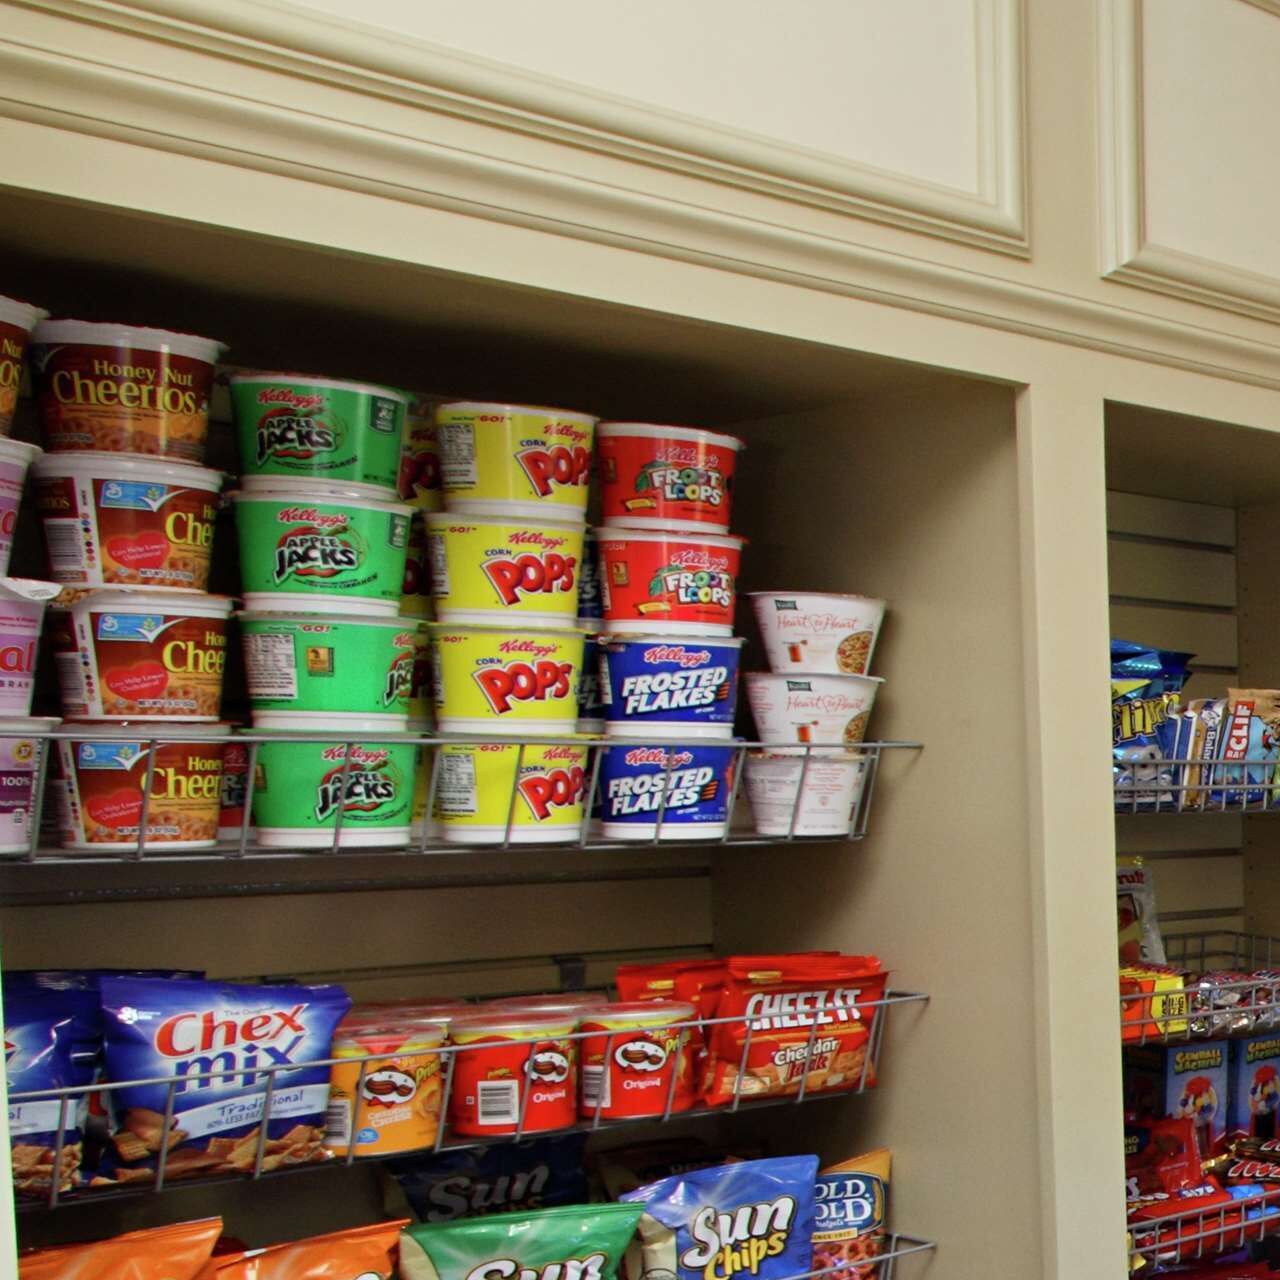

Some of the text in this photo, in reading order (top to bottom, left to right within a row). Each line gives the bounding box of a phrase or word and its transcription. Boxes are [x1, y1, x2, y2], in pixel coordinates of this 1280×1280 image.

[94, 357, 193, 388] Honey Nut
[51, 369, 197, 416] Cheerios
[258, 387, 324, 407] Kellogg's
[264, 417, 315, 430] APPLE
[256, 428, 336, 467] JACKS
[520, 439, 547, 448] CORN
[651, 467, 722, 487] FROOT
[664, 485, 723, 506] LOOPS
[277, 508, 347, 527] Kellogg's
[286, 535, 338, 549] APPLE
[484, 548, 513, 557] CORN
[508, 531, 568, 549] Kellogg's
[272, 546, 358, 587] JACKS
[480, 551, 577, 608] POPS
[665, 571, 731, 590] FROOT
[678, 587, 732, 607] LOOPS
[475, 658, 503, 666] CORN
[499, 639, 562, 657] Kellogg's
[644, 645, 712, 667] Kellogg's
[472, 659, 575, 716] POPS
[622, 666, 728, 698] FROSTED
[625, 685, 717, 715] FLAKES
[1229, 703, 1252, 750] CLIF
[322, 745, 389, 763] Kelogg's
[608, 766, 714, 800] FROSTED
[611, 785, 700, 817] FLAKES
[154, 1002, 309, 1058] Chex
[174, 1034, 305, 1096] mix
[773, 1036, 838, 1066] Chedar
[217, 1089, 304, 1117] Tradiional
[680, 1195, 797, 1271] Sun
